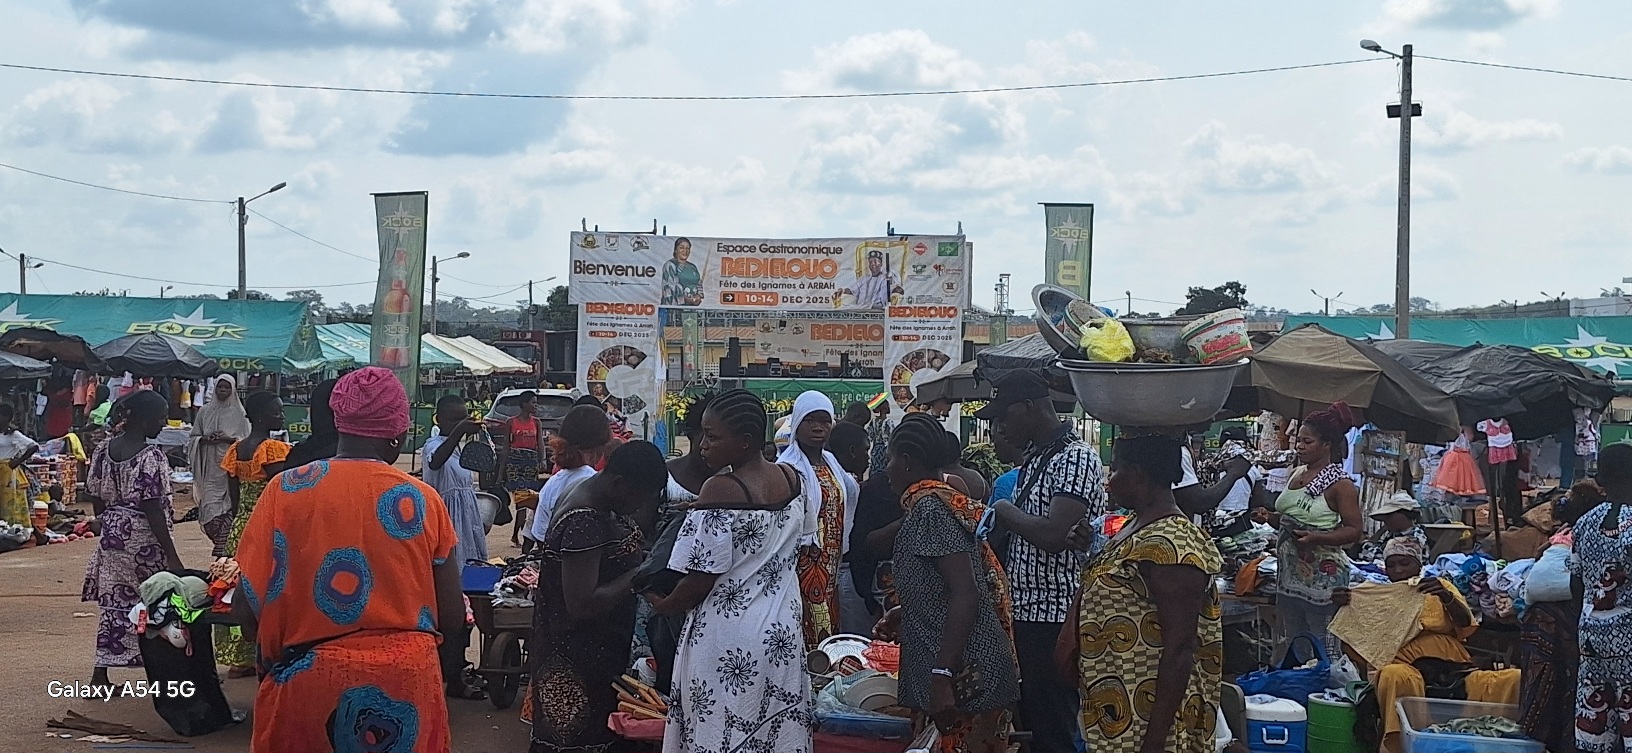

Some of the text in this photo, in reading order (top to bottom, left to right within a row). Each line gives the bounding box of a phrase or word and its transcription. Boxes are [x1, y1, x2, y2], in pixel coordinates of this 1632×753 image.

[717, 243, 843, 256] Espace Gastronomique
[573, 260, 656, 277] Bienvenue
[719, 280, 738, 288] Fête
[758, 281, 796, 290] Ignames
[799, 281, 805, 289] à
[808, 282, 835, 290] ARRAH
[745, 294, 830, 304] 10-14 DEC 2025
[126, 321, 248, 339] BOCK
[1296, 499, 1313, 513] PINK
